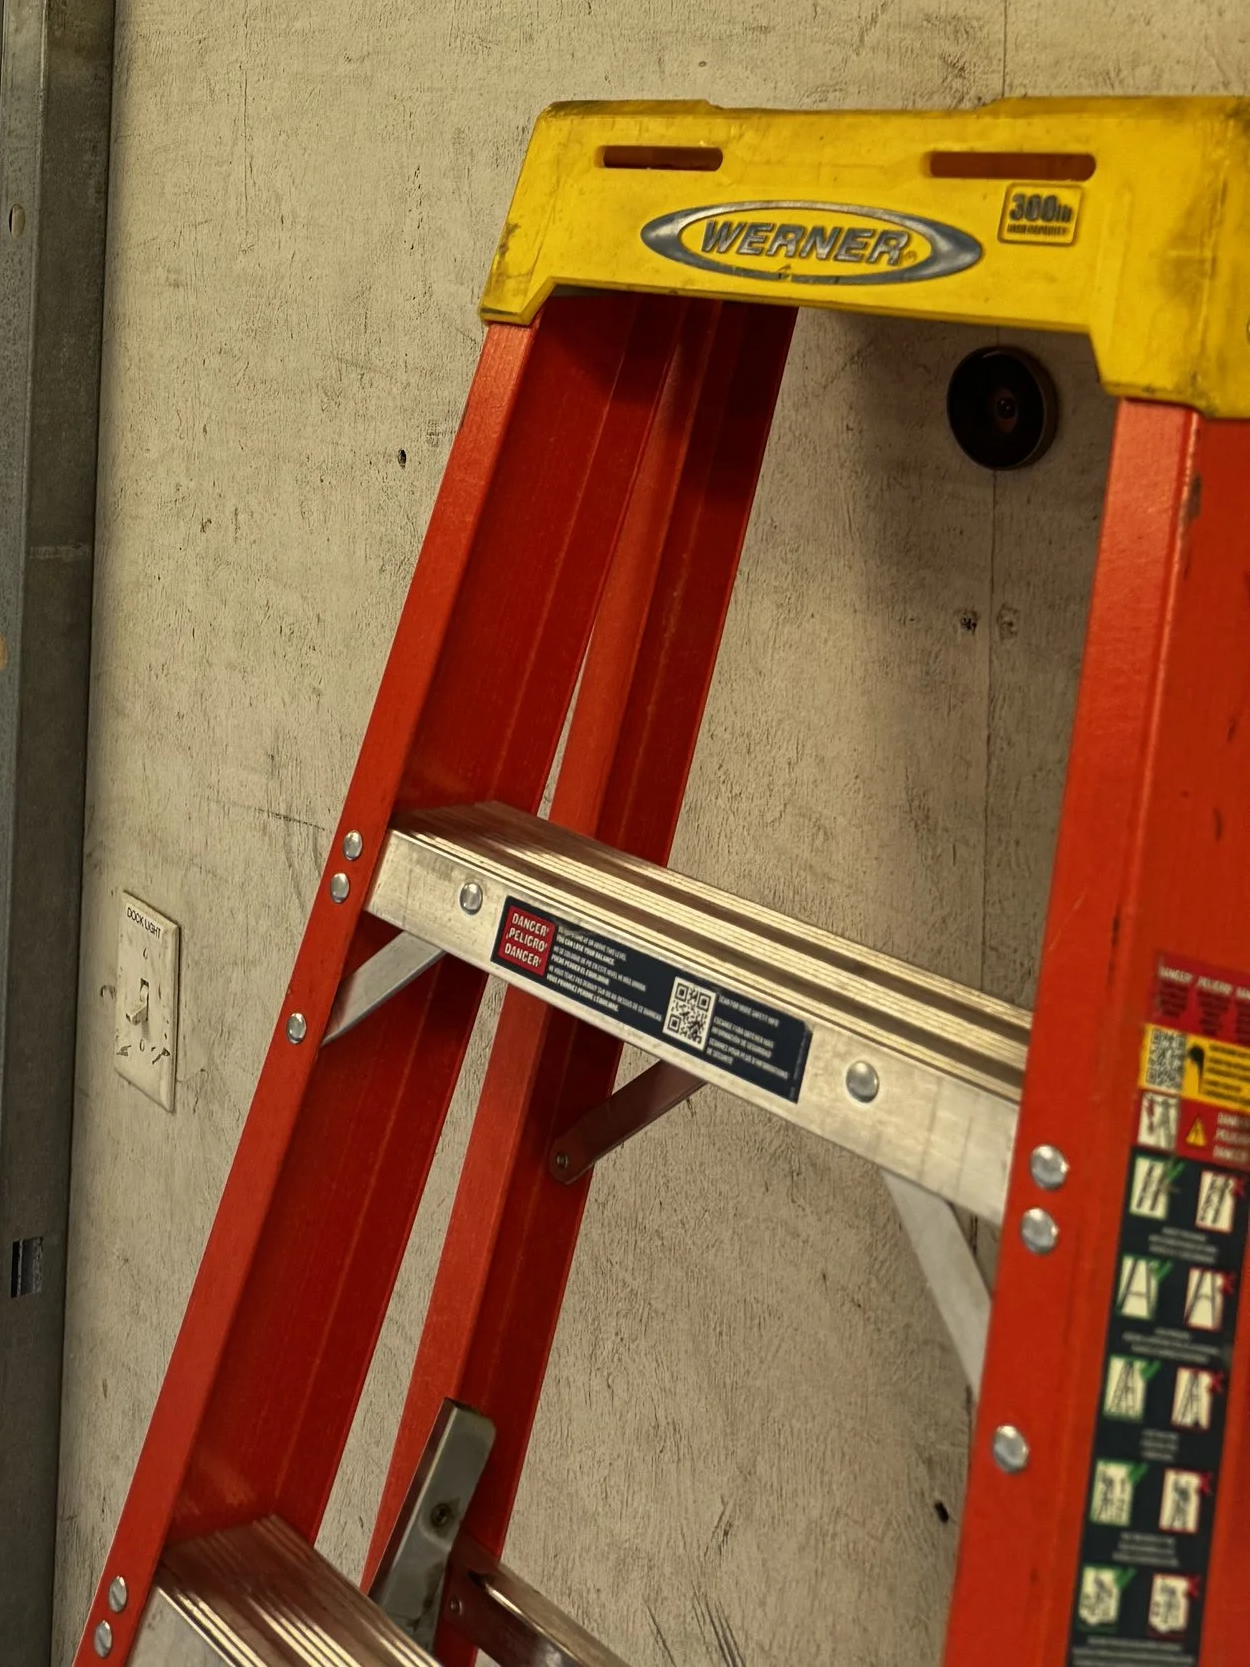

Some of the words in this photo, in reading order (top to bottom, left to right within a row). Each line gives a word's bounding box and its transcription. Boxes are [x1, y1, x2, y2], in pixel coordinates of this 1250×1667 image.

[701, 220, 909, 266] WERNER
[126, 906, 144, 927] DOCK
[144, 919, 161, 939] LIGHT
